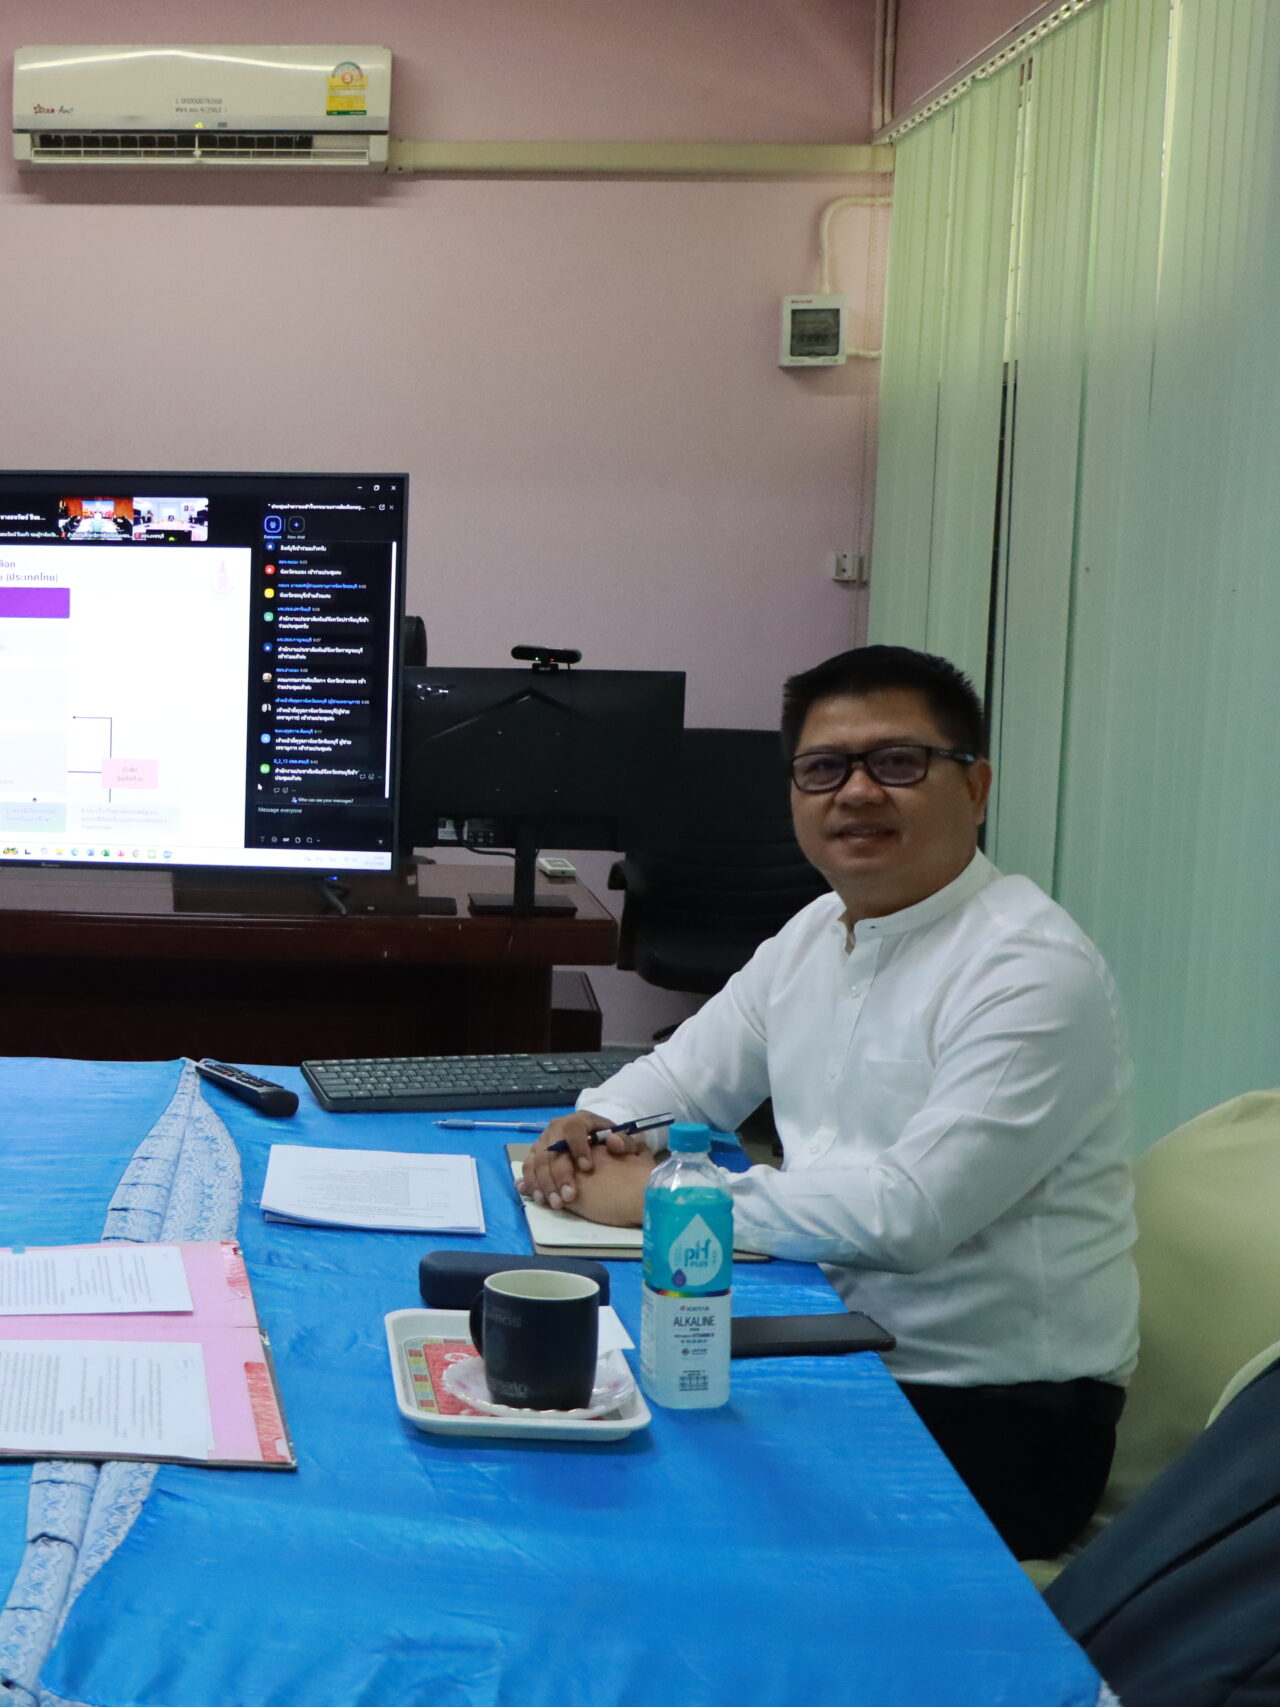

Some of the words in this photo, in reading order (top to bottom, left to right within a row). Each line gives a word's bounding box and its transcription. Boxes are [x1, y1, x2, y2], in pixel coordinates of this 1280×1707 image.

[6, 571, 59, 583] (ประเทศไทย)
[684, 1238, 711, 1267] pH
[673, 1316, 715, 1327] ALKALINE
